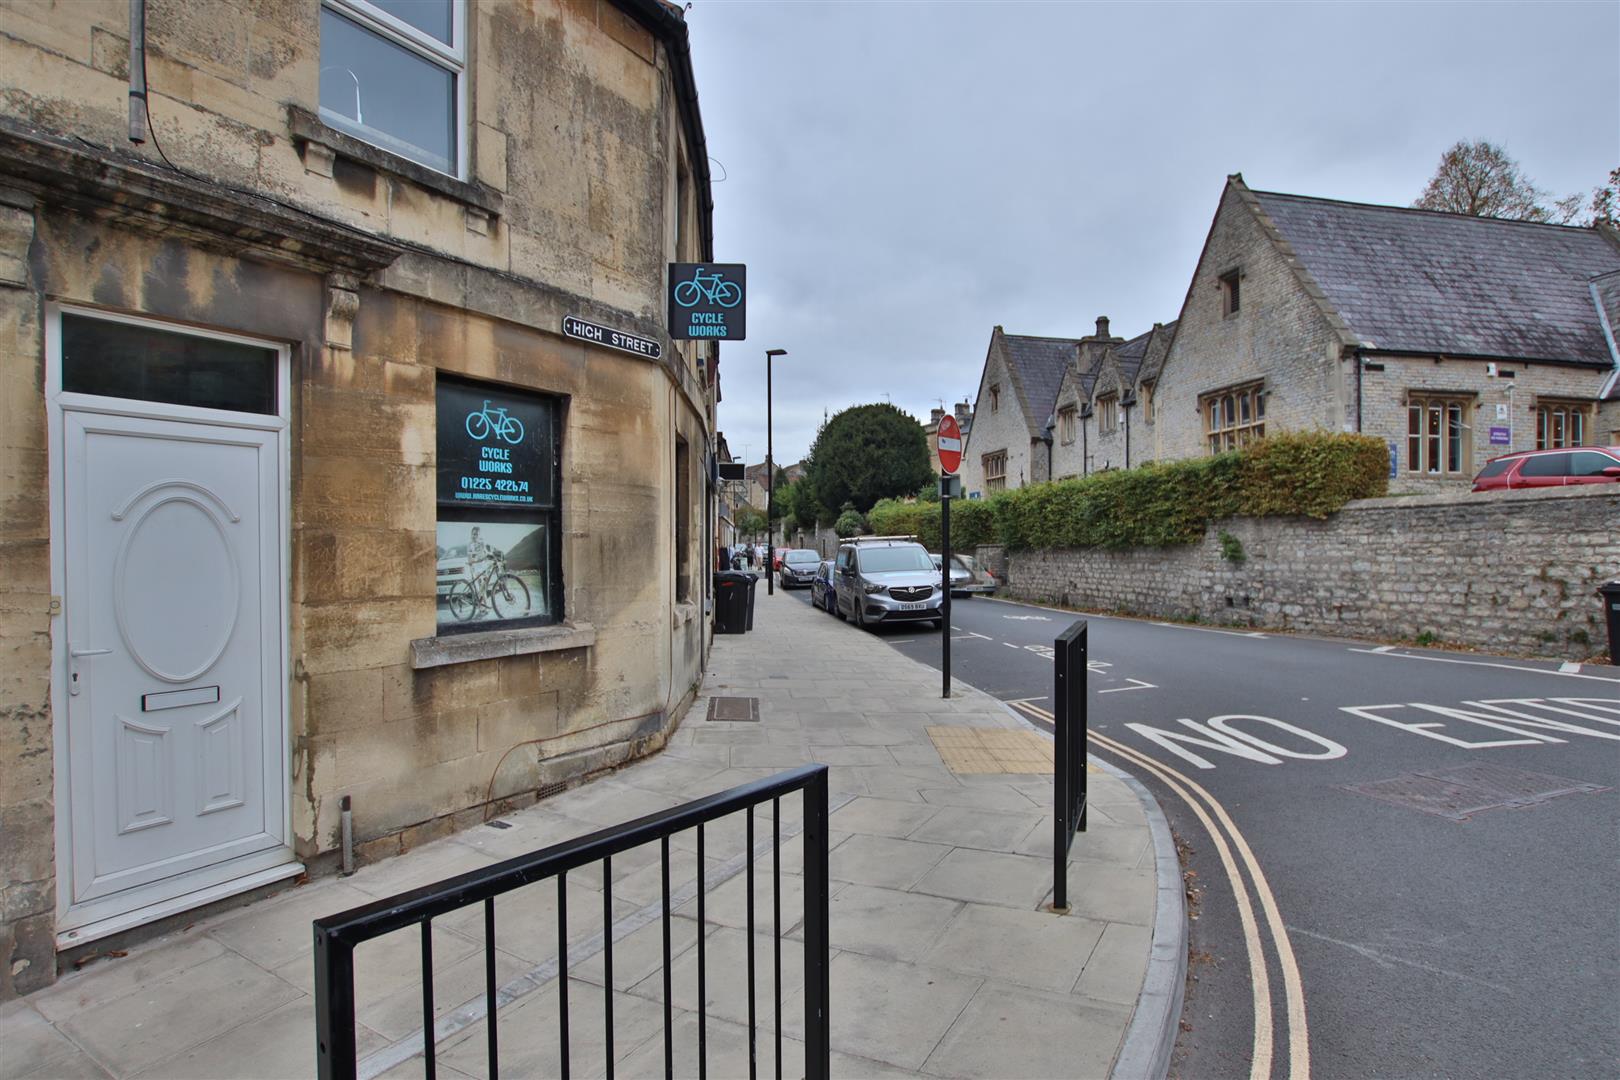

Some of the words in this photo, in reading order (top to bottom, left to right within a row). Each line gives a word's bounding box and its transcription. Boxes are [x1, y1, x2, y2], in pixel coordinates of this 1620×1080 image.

[691, 312, 724, 324] CYCLE
[573, 321, 602, 341] HIGH
[612, 334, 652, 354] STREET
[688, 325, 727, 337] WORKS
[481, 446, 510, 460] CYCLE
[479, 460, 512, 473] WORKS
[461, 477, 492, 490] 01225
[495, 479, 529, 493] 422674
[1124, 714, 1348, 770] NO
